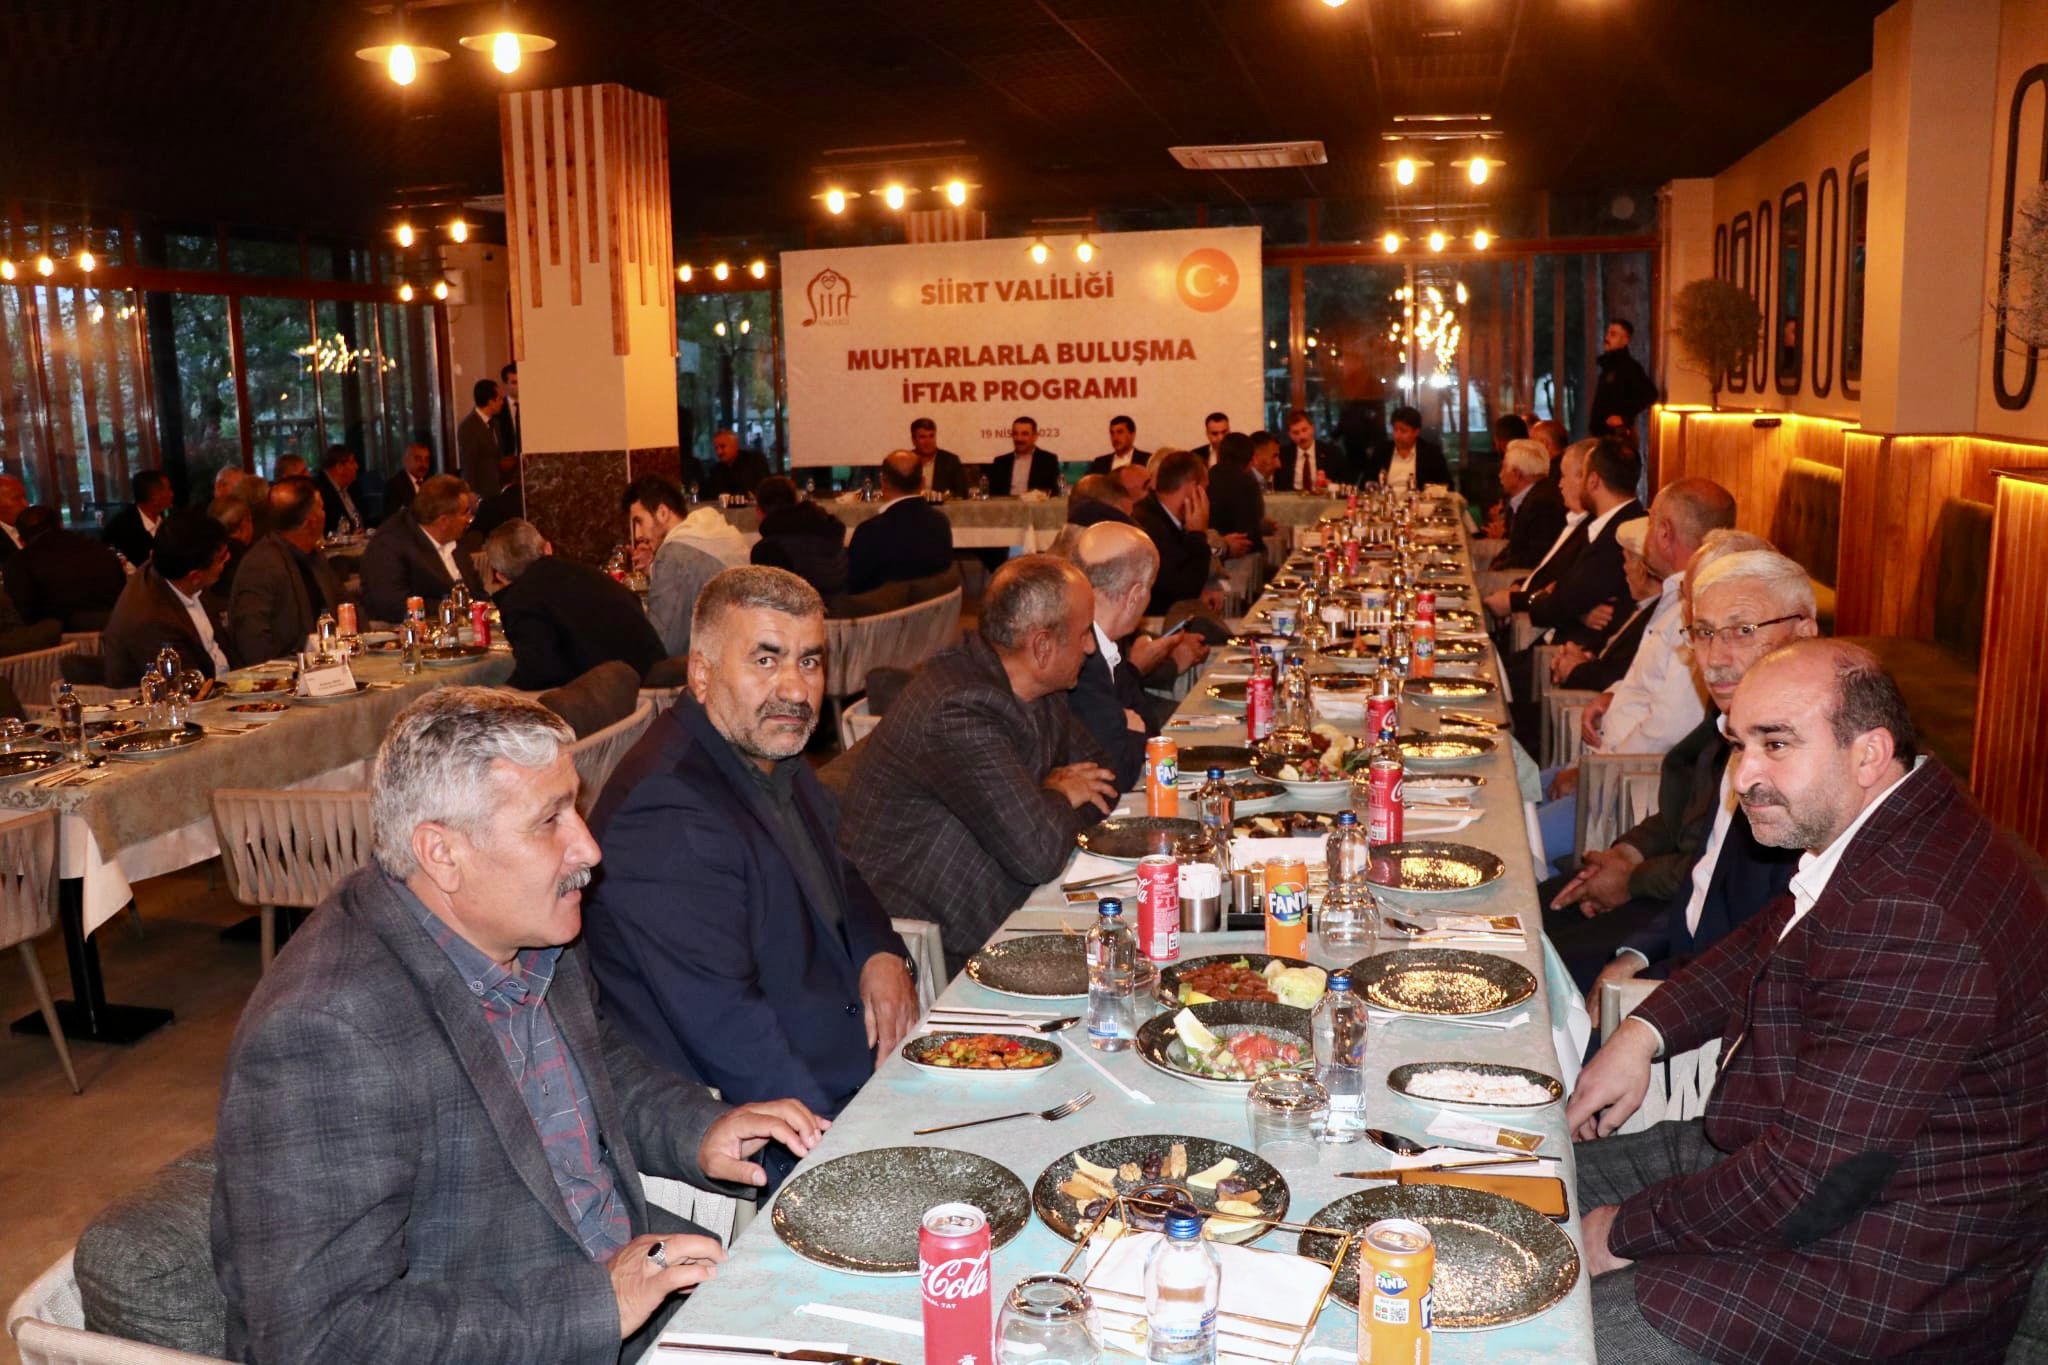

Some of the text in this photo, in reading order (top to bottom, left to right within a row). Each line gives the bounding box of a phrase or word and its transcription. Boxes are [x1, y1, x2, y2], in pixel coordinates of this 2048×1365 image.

[921, 271, 1115, 305] SİİRT VALİLİĞİ
[848, 339, 1197, 371] MUHTARLARLA BULUŞMA
[903, 376, 1138, 404] İFTAR PROGRAMI
[981, 426, 1060, 439] 19 NİS 023
[1155, 763, 1178, 783] FAN
[1268, 889, 1308, 915] FANT
[1375, 1274, 1408, 1290] FANTA
